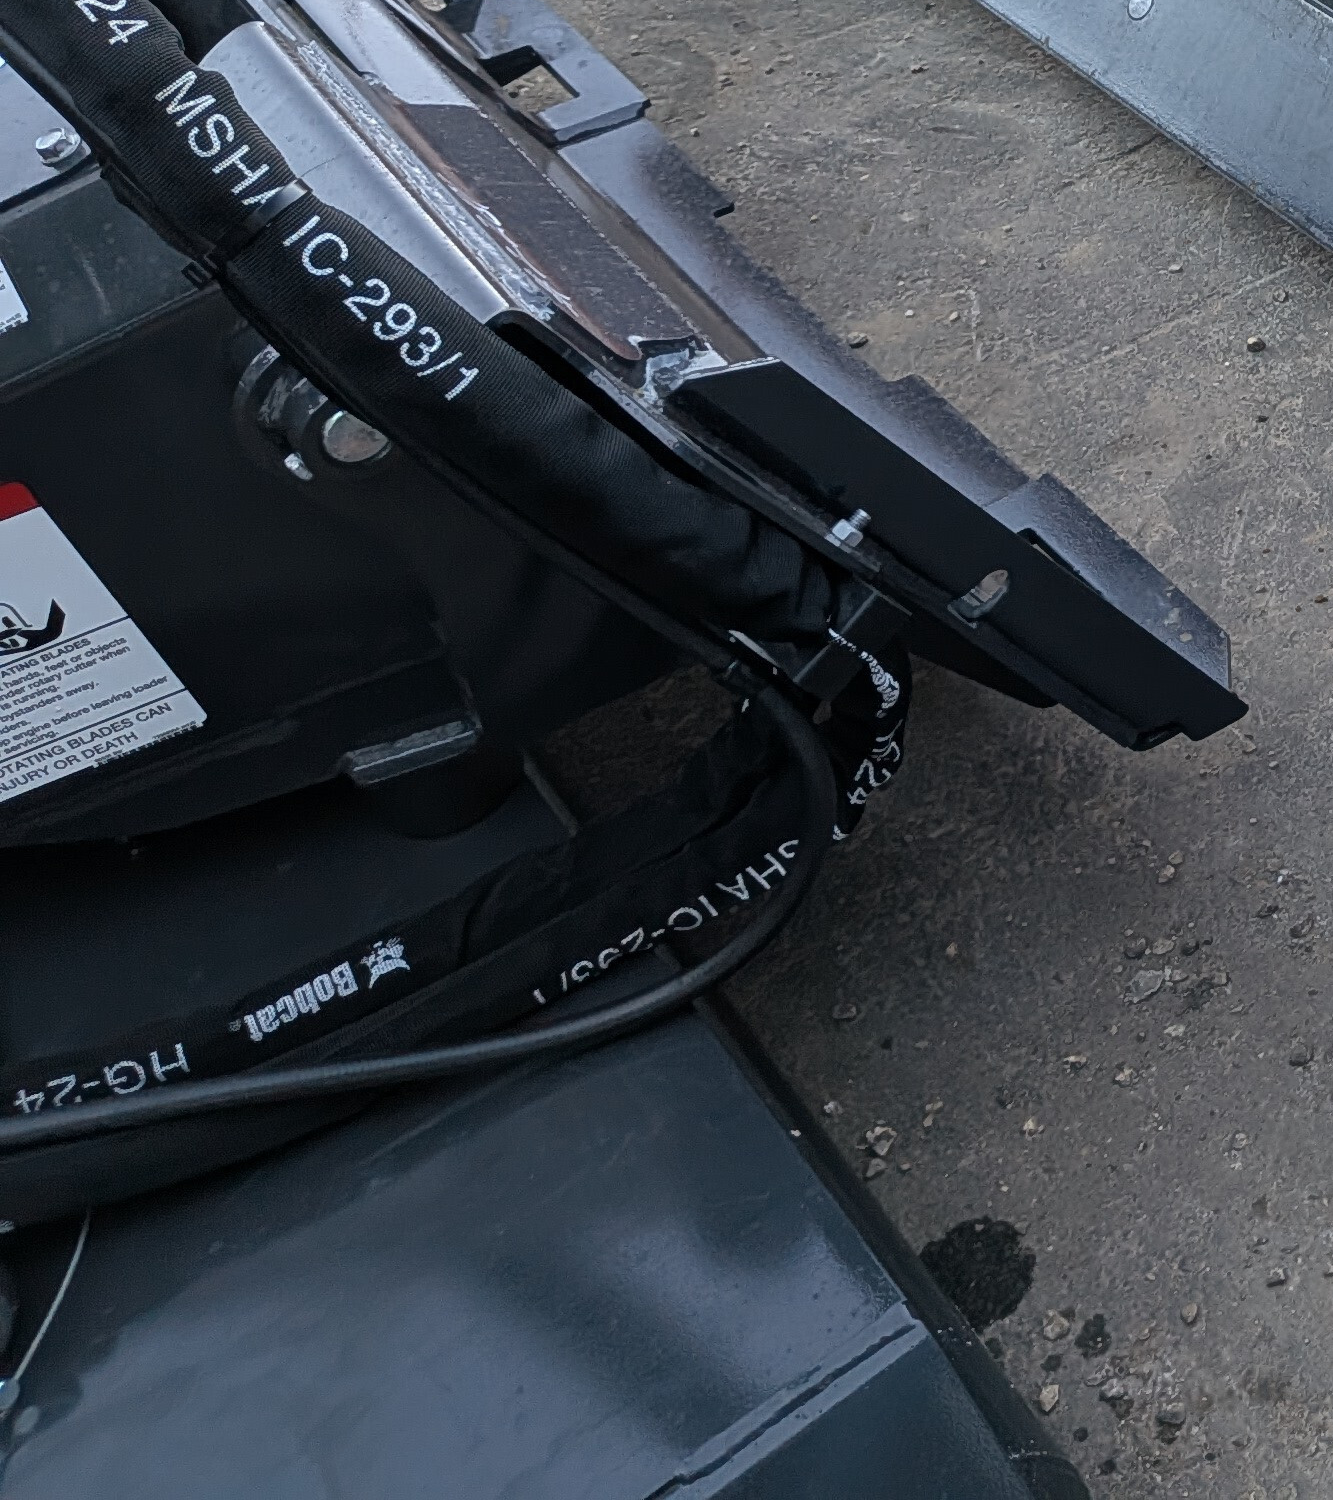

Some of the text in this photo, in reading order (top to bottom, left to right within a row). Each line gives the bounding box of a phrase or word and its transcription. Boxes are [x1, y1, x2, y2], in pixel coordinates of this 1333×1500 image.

[282, 214, 481, 401] IC-293/1
[29, 672, 62, 691] rotary
[63, 658, 98, 676] cutter
[98, 645, 131, 663] when
[40, 637, 92, 663] BLADES
[69, 653, 83, 664] or
[85, 636, 128, 658] objects
[12, 722, 53, 743] engine
[51, 706, 92, 725] before
[90, 689, 133, 711] leaving
[131, 675, 168, 694] loader
[13, 686, 61, 706] running.
[65, 680, 100, 698] away.
[66, 717, 135, 750] BLADES
[135, 702, 173, 723] CAN
[52, 753, 82, 771] OR
[82, 731, 140, 760] DEATH
[243, 960, 359, 1042] Bobcat
[13, 1042, 191, 1114] HG-24
